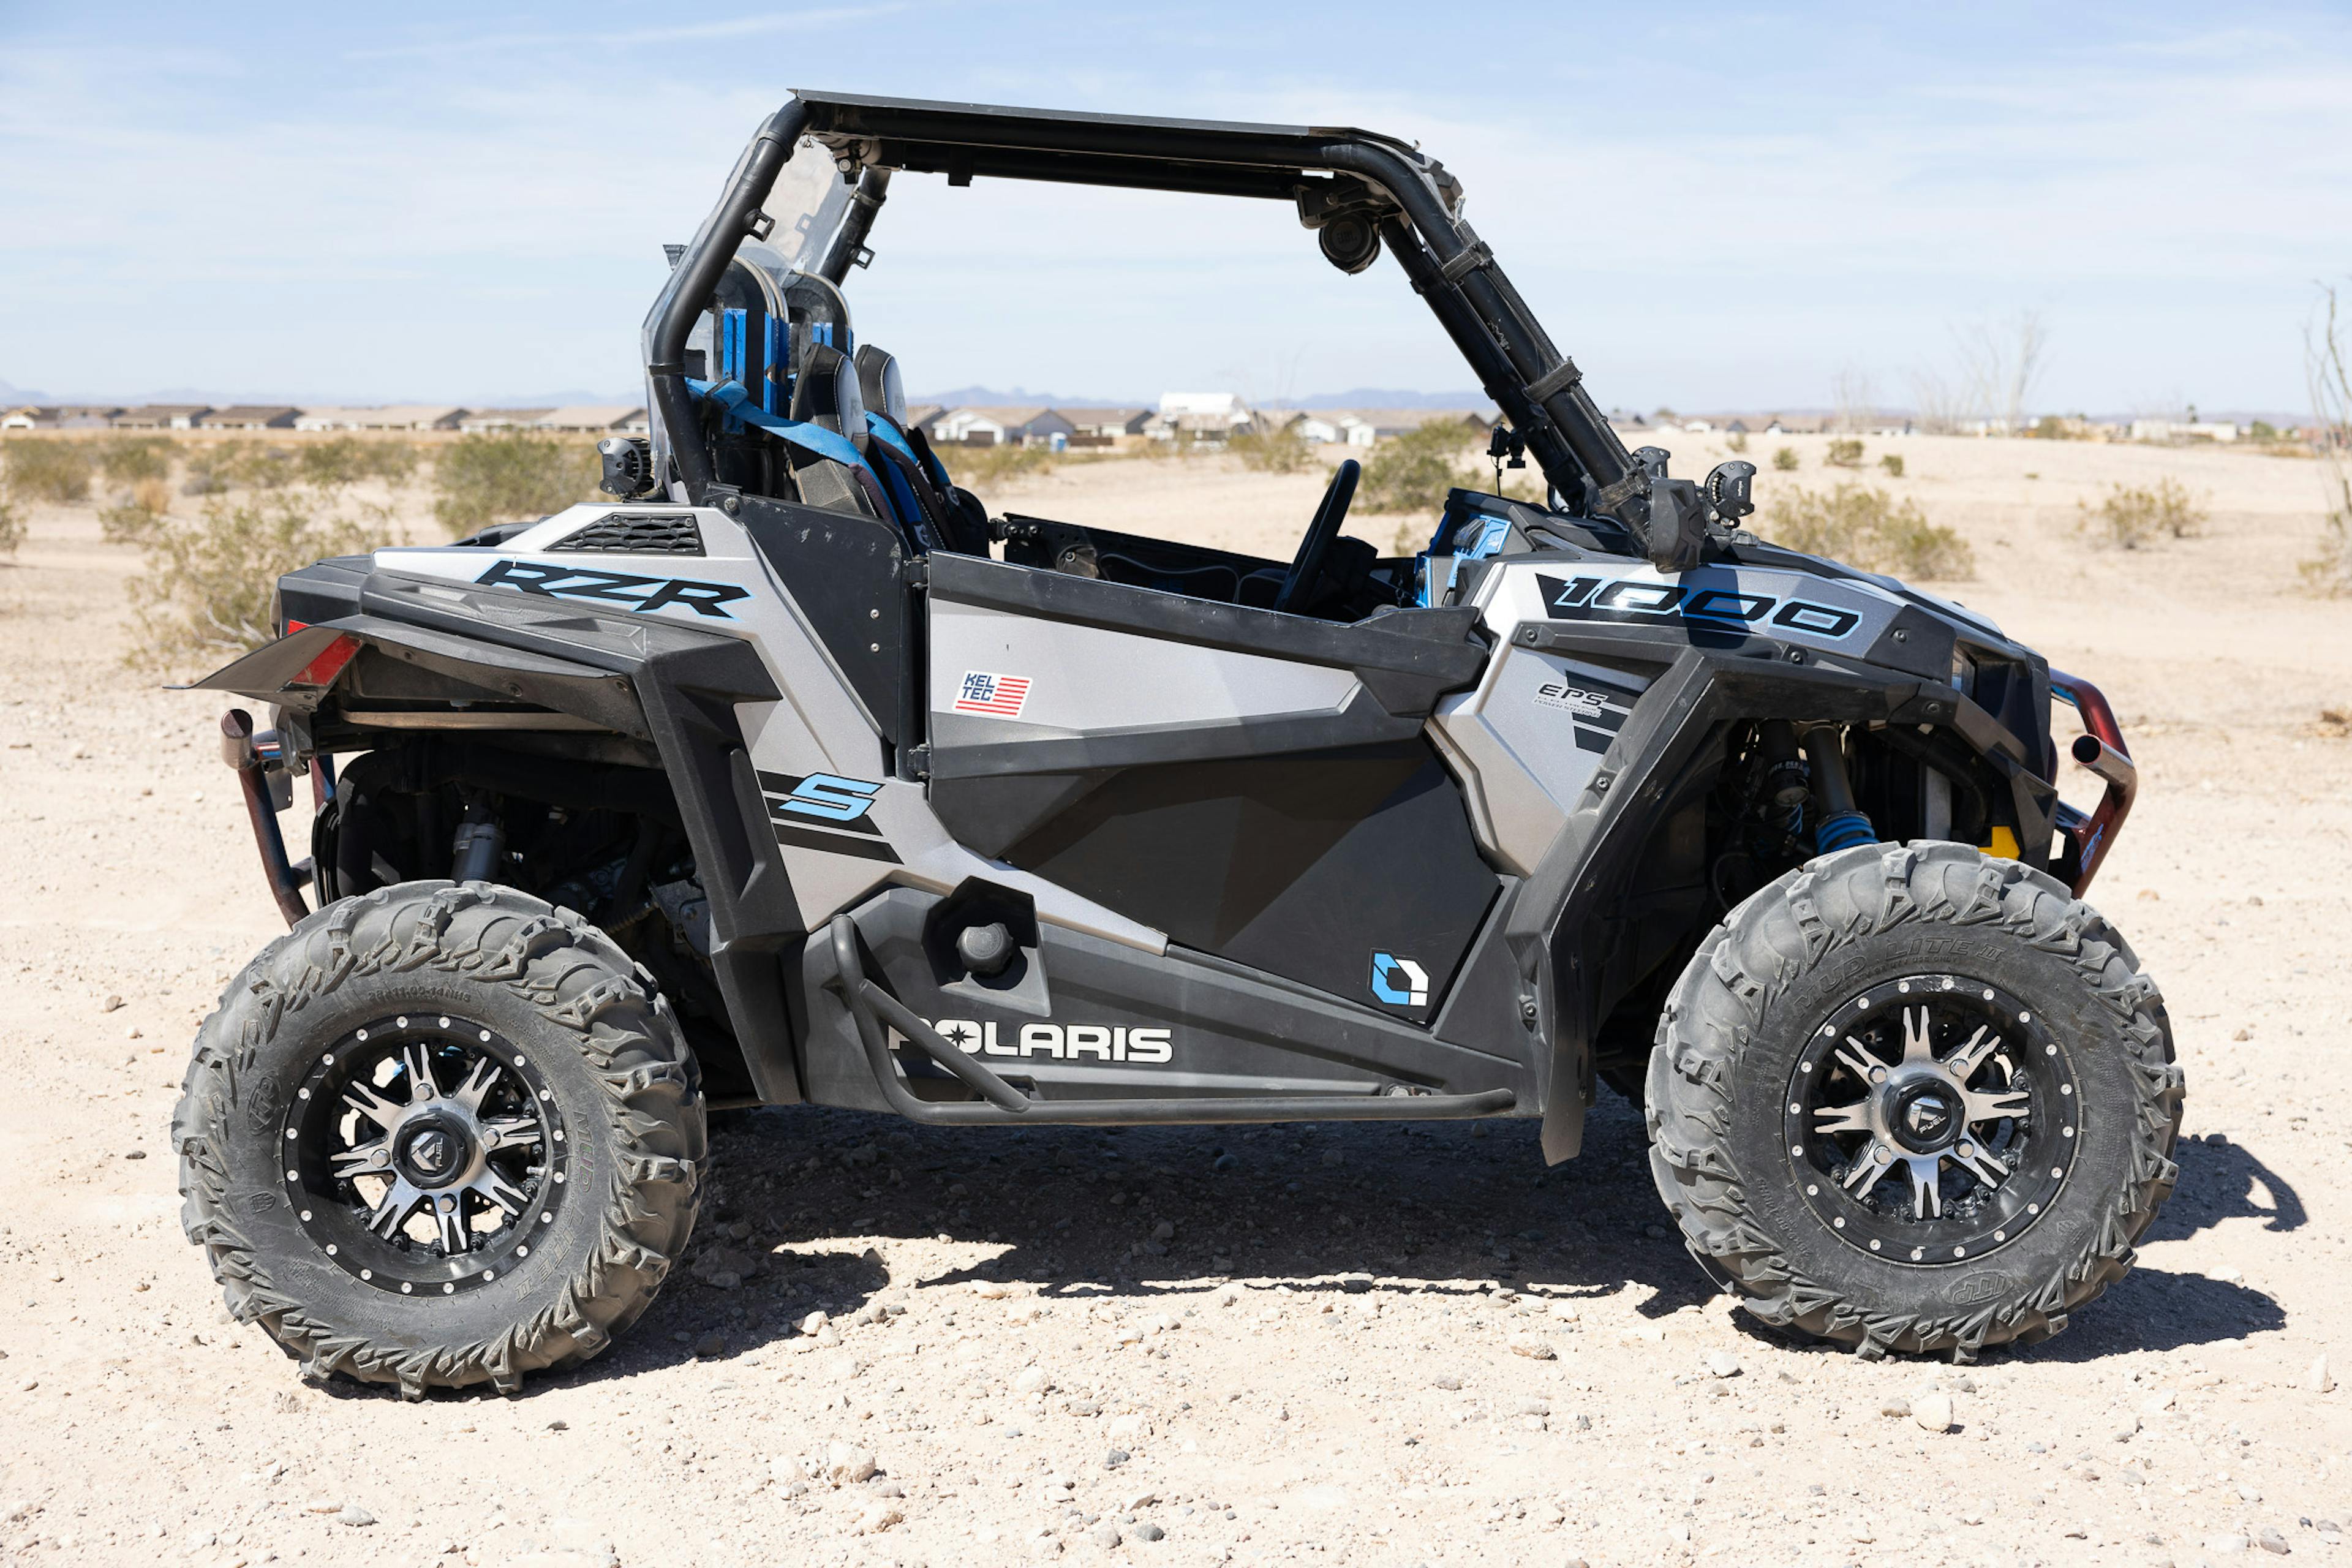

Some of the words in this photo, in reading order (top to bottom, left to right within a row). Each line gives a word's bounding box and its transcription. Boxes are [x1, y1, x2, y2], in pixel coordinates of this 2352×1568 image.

[474, 560, 751, 619] RZR
[1555, 575, 1863, 640] 1000
[962, 686, 993, 701] TEC
[964, 673, 995, 688] KEL
[1539, 683, 1607, 706] EPS
[778, 772, 886, 821] S
[1793, 954, 1868, 1018] MUD
[1885, 937, 1973, 961] LITE
[1918, 1116, 1947, 1134] FUEL
[435, 1137, 443, 1167] FUEL
[573, 1111, 594, 1193] MUD
[1953, 1274, 2005, 1303] ITP
